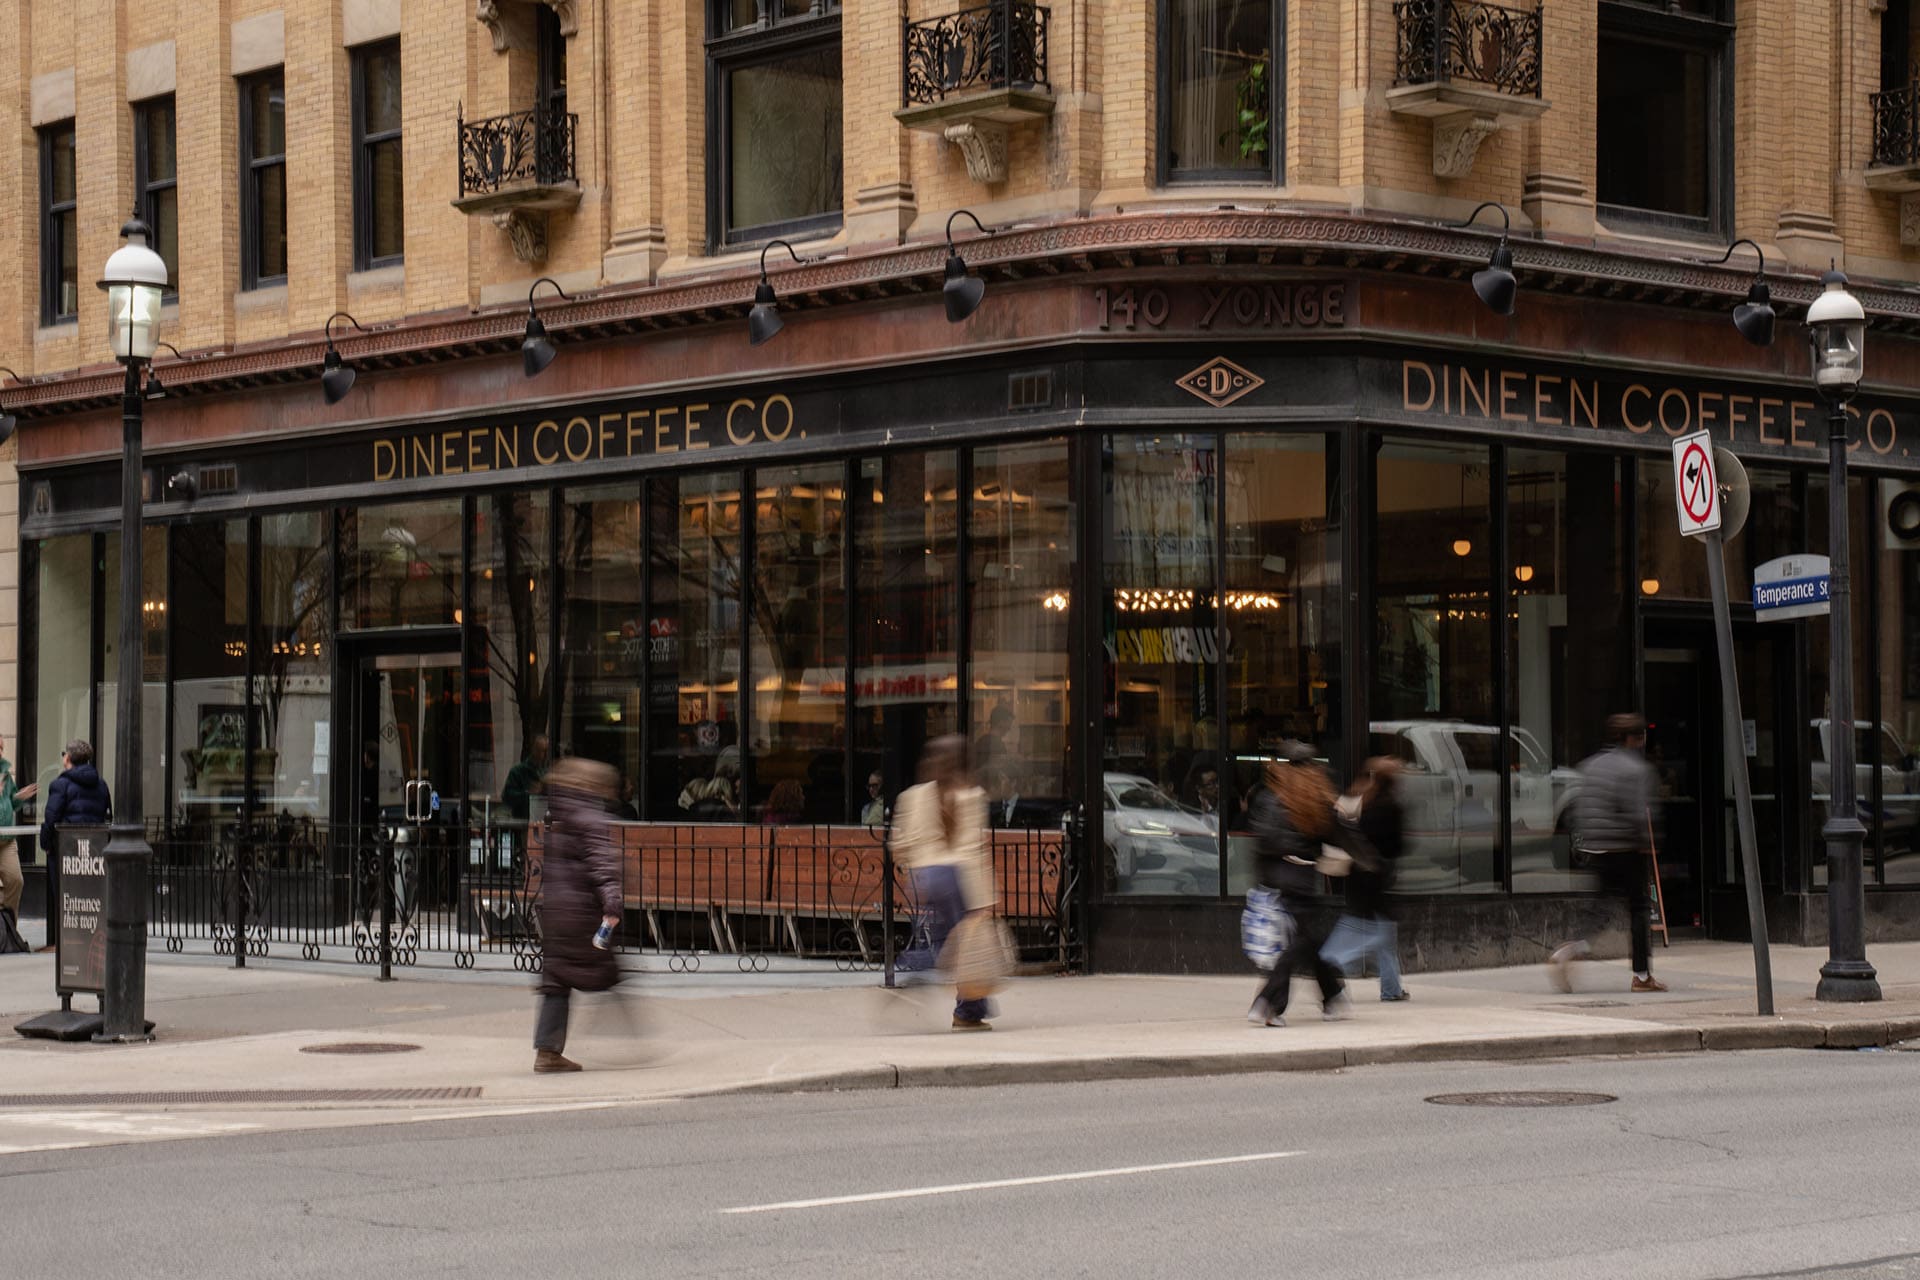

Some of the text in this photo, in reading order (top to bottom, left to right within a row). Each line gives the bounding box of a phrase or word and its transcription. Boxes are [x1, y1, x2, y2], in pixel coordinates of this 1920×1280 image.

[1096, 284, 1346, 331] 140 YONGE
[1403, 360, 1598, 429] DINEEN
[1621, 384, 1816, 448] COFFEE
[374, 394, 807, 482] DINEEN COFFEE CO.
[1755, 580, 1828, 606] Temperance St
[78, 839, 90, 856] THE
[62, 856, 105, 875] FREDERICK
[63, 893, 101, 913] Entrance
[63, 911, 98, 933] this way
